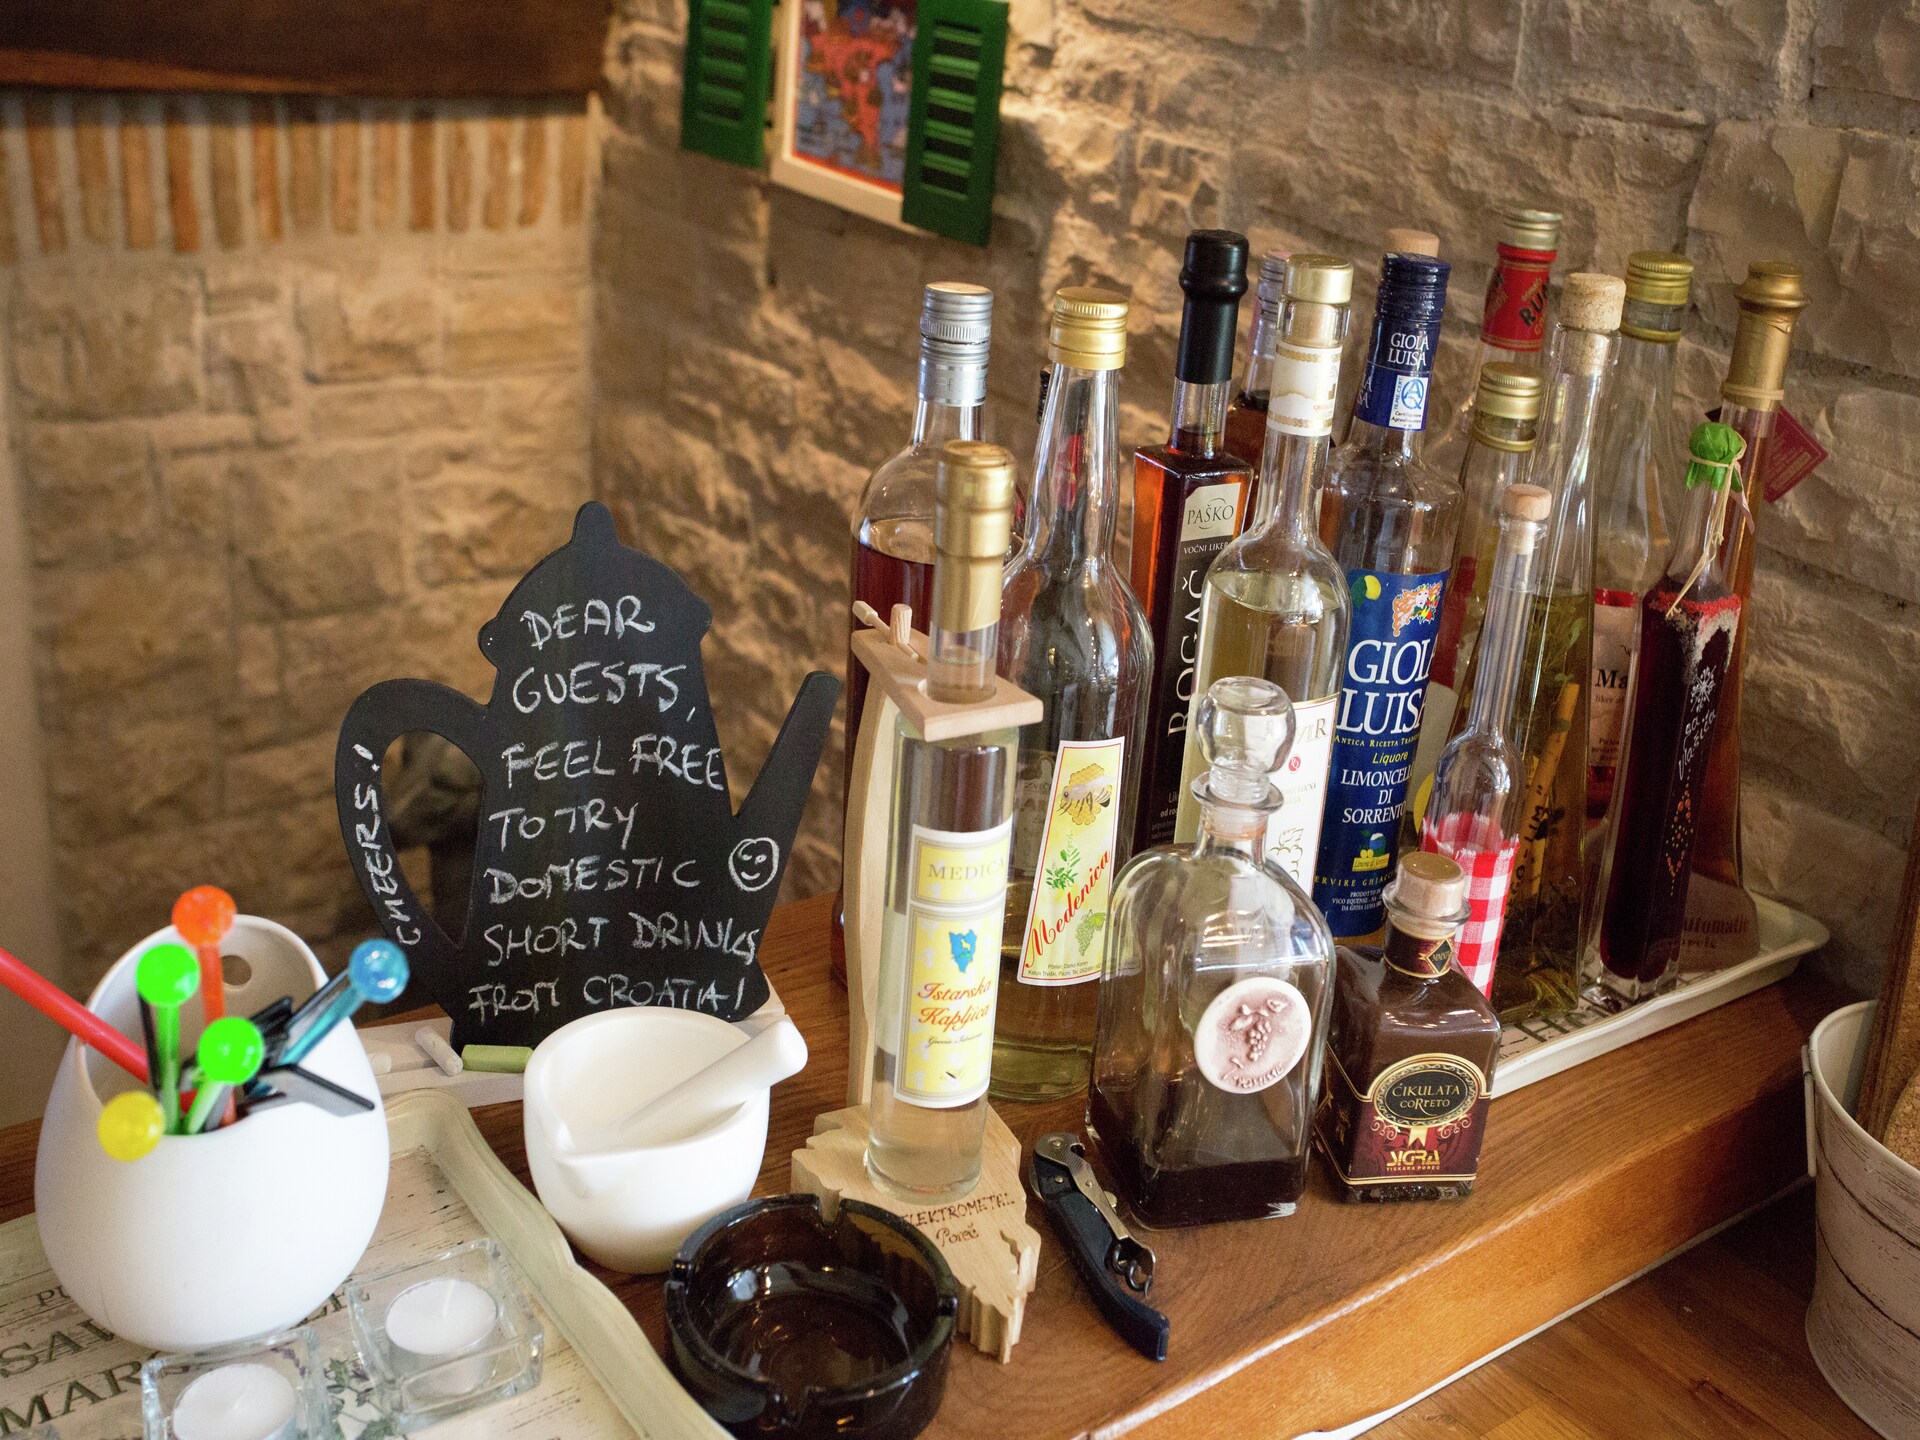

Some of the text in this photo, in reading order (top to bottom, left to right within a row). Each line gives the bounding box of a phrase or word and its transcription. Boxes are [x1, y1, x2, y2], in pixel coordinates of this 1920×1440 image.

[1391, 331, 1429, 351] GIOIA
[1388, 348, 1427, 366] LUISA
[1188, 504, 1234, 524] PAŠKO
[520, 594, 655, 650] DEAR
[513, 661, 696, 721] GUESTS,
[1335, 734, 1365, 747] ANTICA
[1370, 739, 1398, 748] RICETTA
[501, 733, 724, 791] FEEL FREE
[1373, 751, 1408, 765] Liquore
[1377, 789, 1393, 806] DI
[488, 798, 638, 850] TO TRY
[483, 855, 701, 904] DOMESTIC
[928, 856, 1006, 881] MEDICA
[1025, 849, 1111, 968] Medenica
[484, 911, 760, 966] SHORT DRINKS
[469, 977, 560, 1026] FROM
[917, 976, 991, 1001] Istarska
[918, 1004, 991, 1032] Kapljica
[1387, 1149, 1440, 1167] SIGRA
